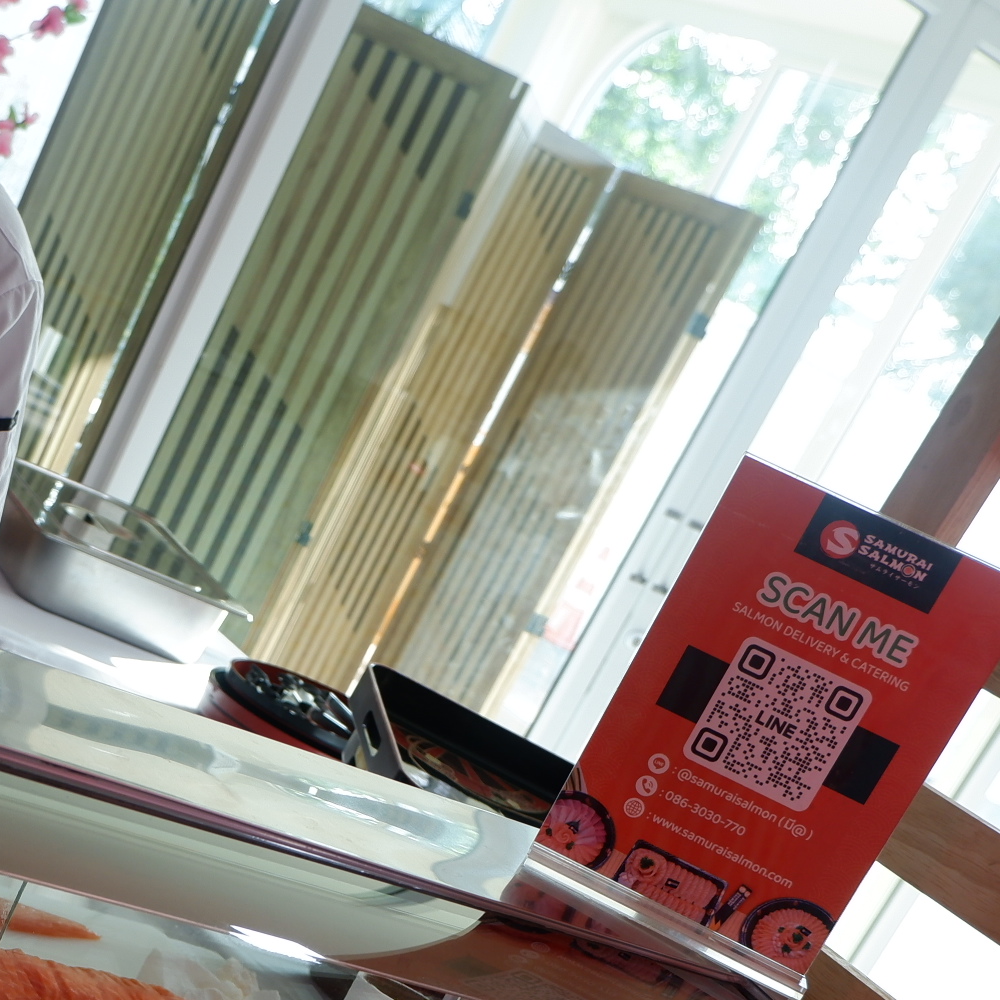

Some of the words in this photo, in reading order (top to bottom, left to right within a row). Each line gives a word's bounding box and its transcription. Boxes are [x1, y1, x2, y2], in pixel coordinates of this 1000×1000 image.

[858, 545, 928, 581] SALMON
[864, 534, 933, 571] SAMURAI
[757, 573, 860, 640] SCAN
[853, 617, 918, 667] ME
[732, 602, 783, 632] SALMON
[783, 626, 841, 658] DELIVERY
[840, 653, 850, 664] &
[851, 658, 910, 692] CATERING
[755, 710, 797, 739] LINE
[665, 791, 746, 836] 086-3030-770
[677, 768, 777, 823] @samuraisalmon
[652, 813, 793, 889] www.samuraisalmon.com
